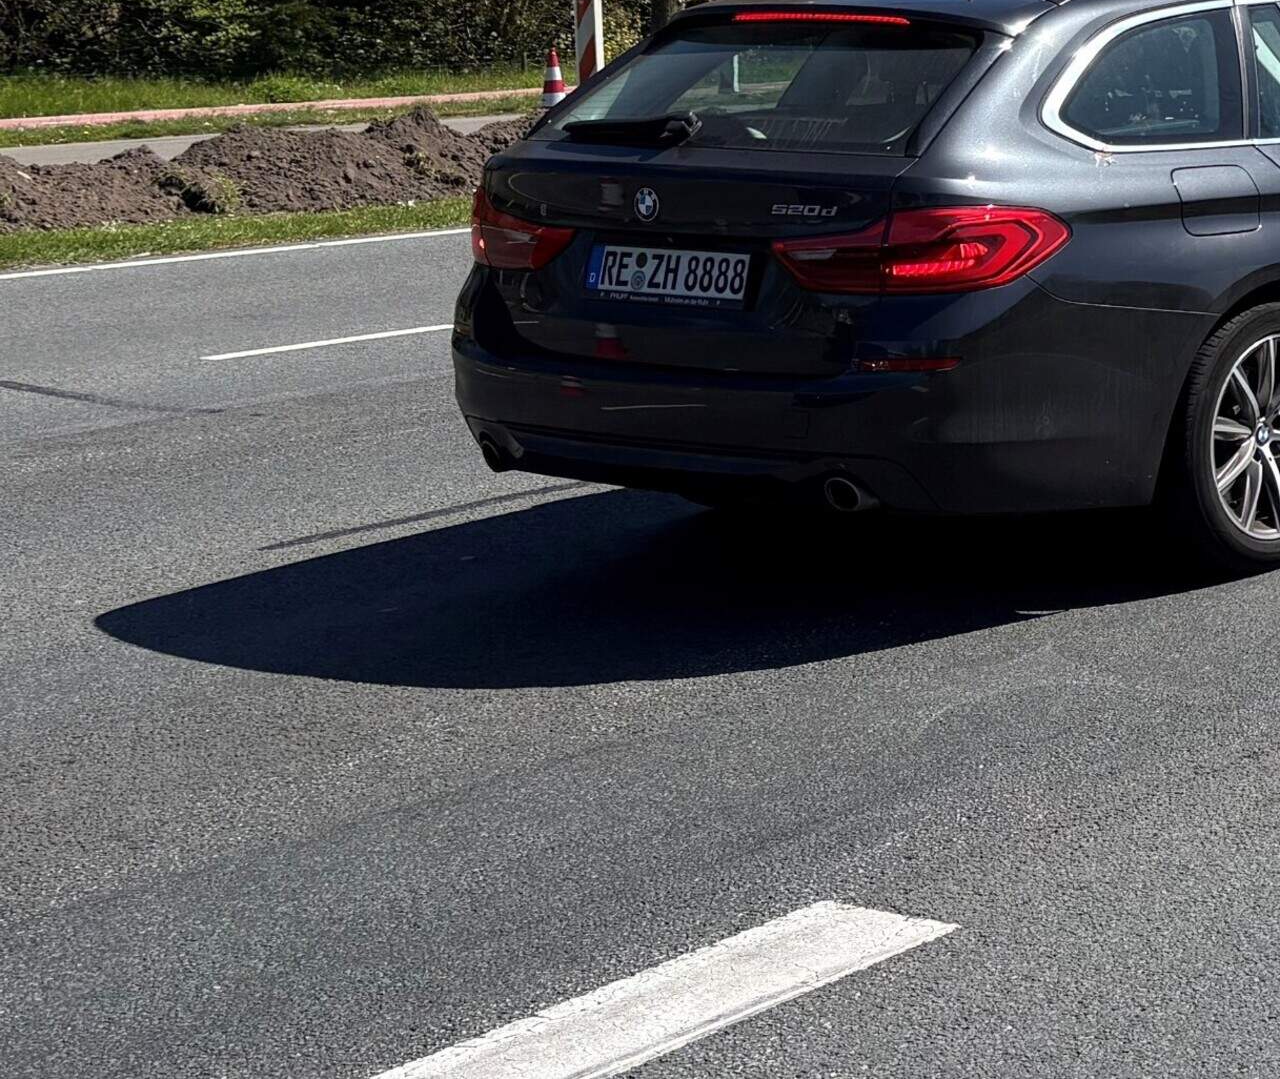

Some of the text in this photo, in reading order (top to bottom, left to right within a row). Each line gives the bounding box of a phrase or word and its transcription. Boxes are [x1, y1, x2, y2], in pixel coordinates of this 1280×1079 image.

[771, 204, 838, 217] 520d
[589, 272, 596, 283] D
[600, 250, 747, 296] RE ZH 8888
